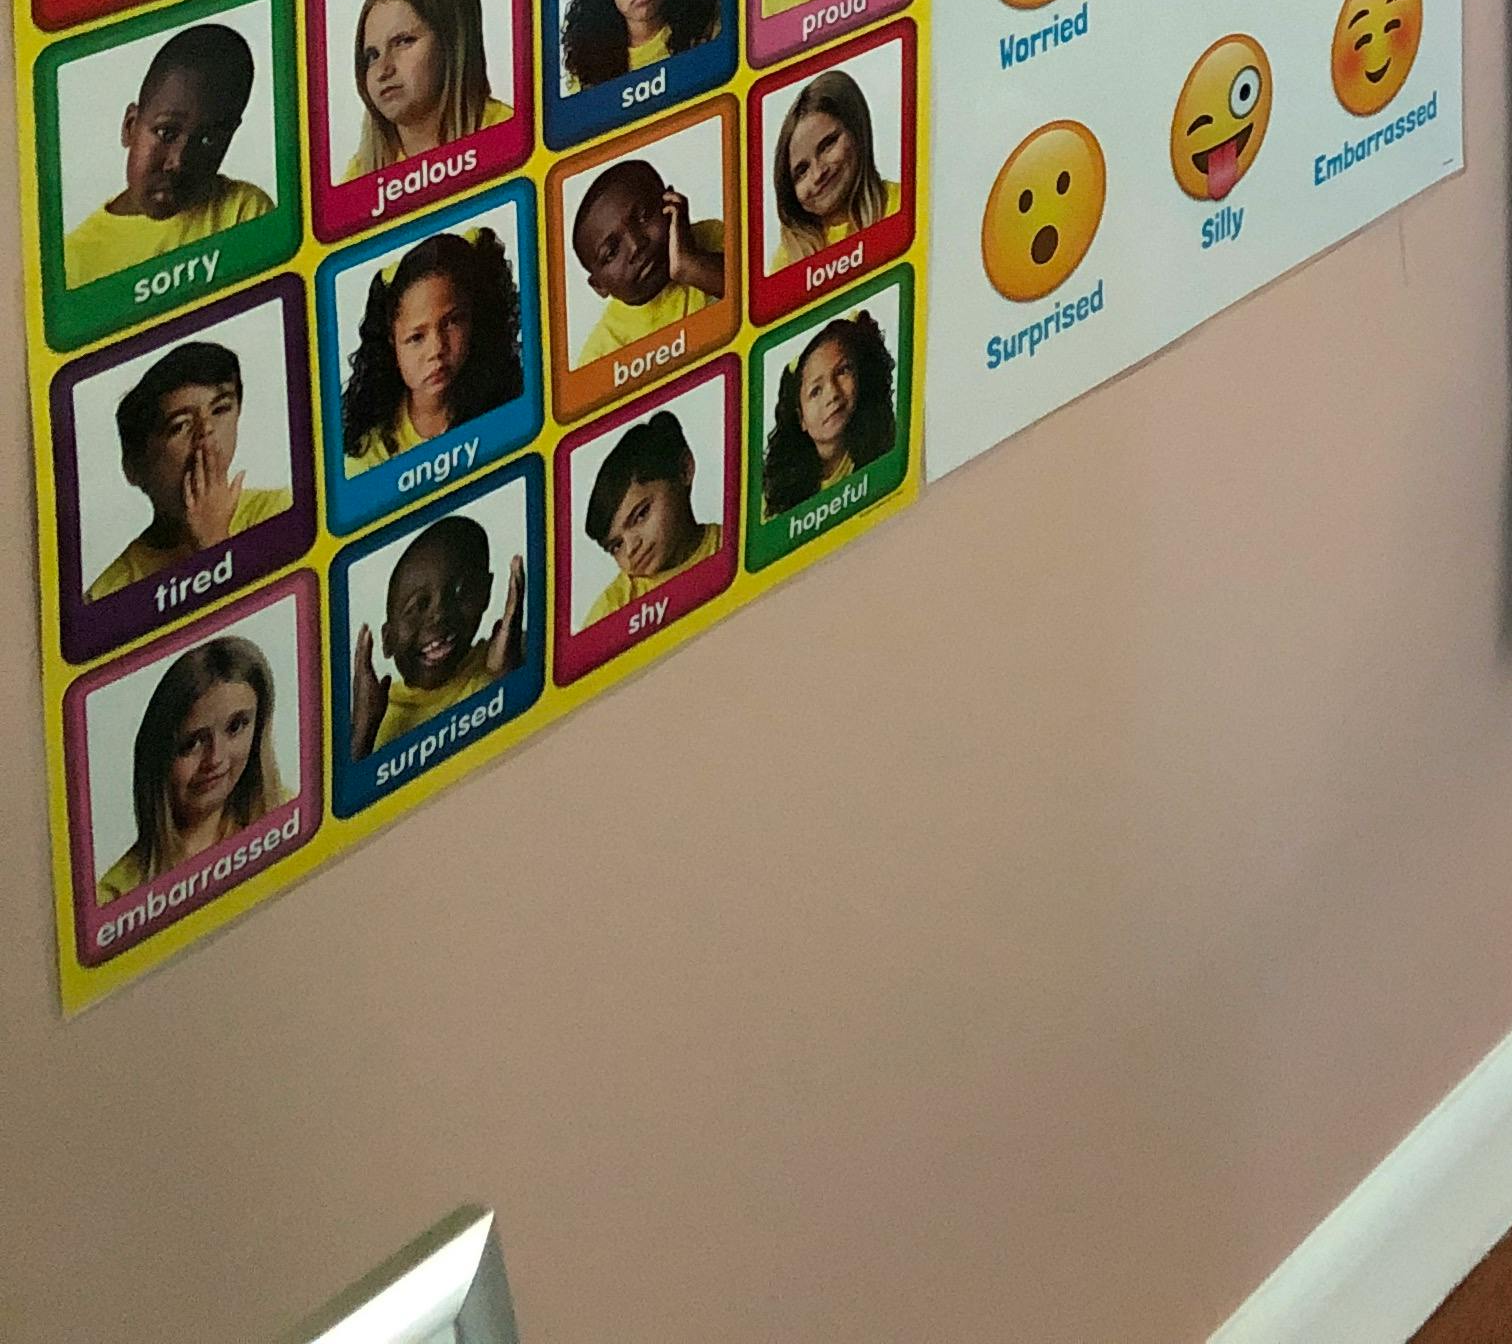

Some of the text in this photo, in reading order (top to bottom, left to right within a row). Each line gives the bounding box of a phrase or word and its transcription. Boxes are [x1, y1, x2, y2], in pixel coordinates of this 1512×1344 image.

[999, 2, 1089, 71] Worried
[621, 66, 667, 109] sad
[1313, 90, 1438, 187] Embarrassed
[371, 148, 477, 217] jealous
[1201, 206, 1245, 251] Silly
[133, 249, 222, 304] sorry
[805, 247, 864, 292] loved
[986, 278, 1105, 371] Surprised
[612, 329, 687, 389] bored
[397, 435, 480, 494] angry
[788, 473, 869, 540] hopeful
[154, 550, 234, 613] tired
[628, 596, 671, 636] shy
[375, 687, 504, 787] surprised
[96, 806, 300, 948] embarrassed
